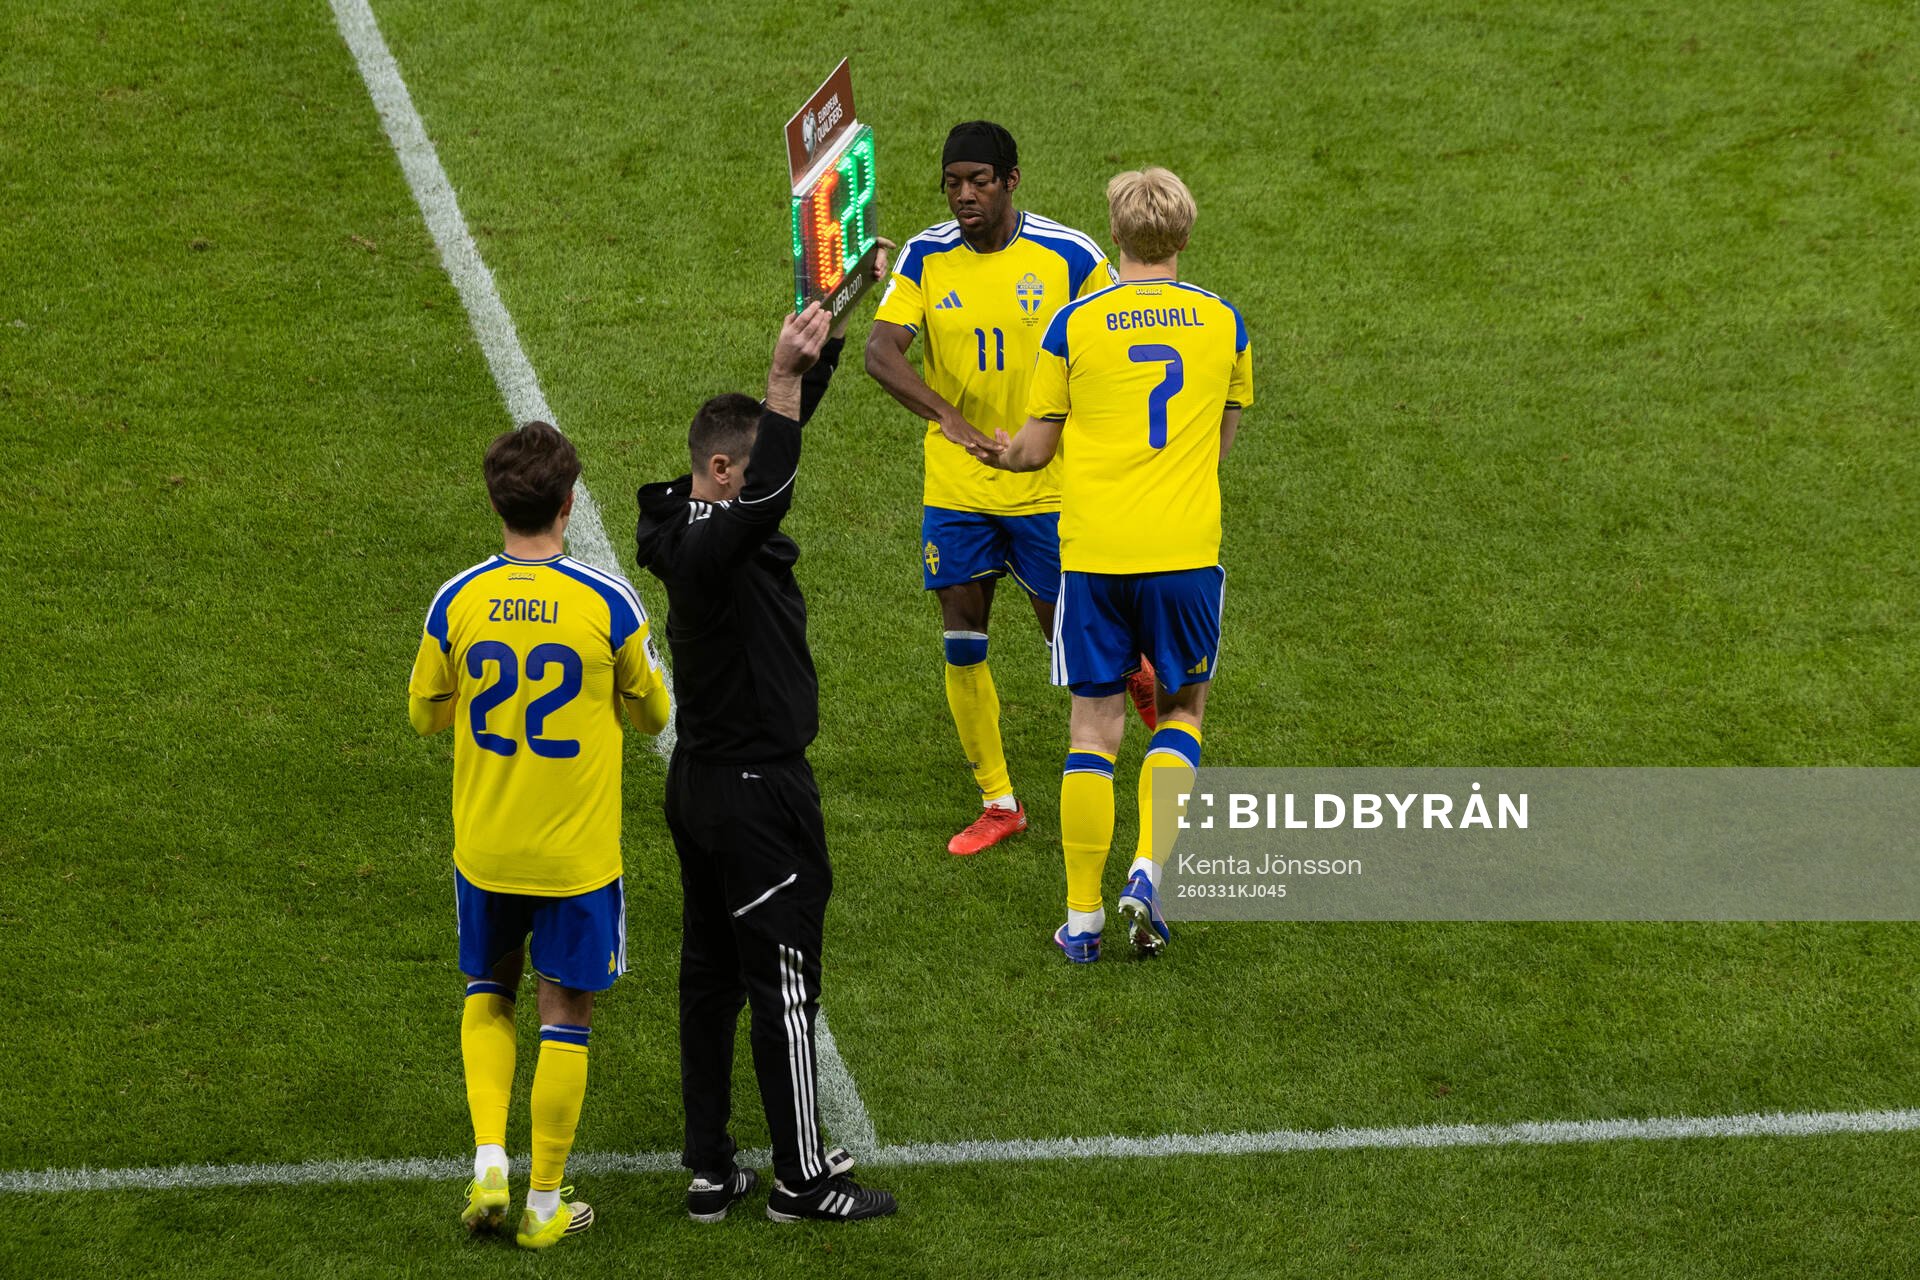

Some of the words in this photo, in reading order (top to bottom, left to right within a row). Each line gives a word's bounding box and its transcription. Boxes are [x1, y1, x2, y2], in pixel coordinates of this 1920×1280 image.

[817, 92, 839, 124] EUROPEAN
[817, 103, 843, 143] QUALIFIERS
[832, 273, 863, 317] UEFA.com
[1106, 307, 1204, 331] BERGVALL
[974, 327, 1005, 371] 11
[1128, 344, 1184, 449] 7
[488, 598, 559, 624] ZENELI
[466, 640, 583, 759] 22
